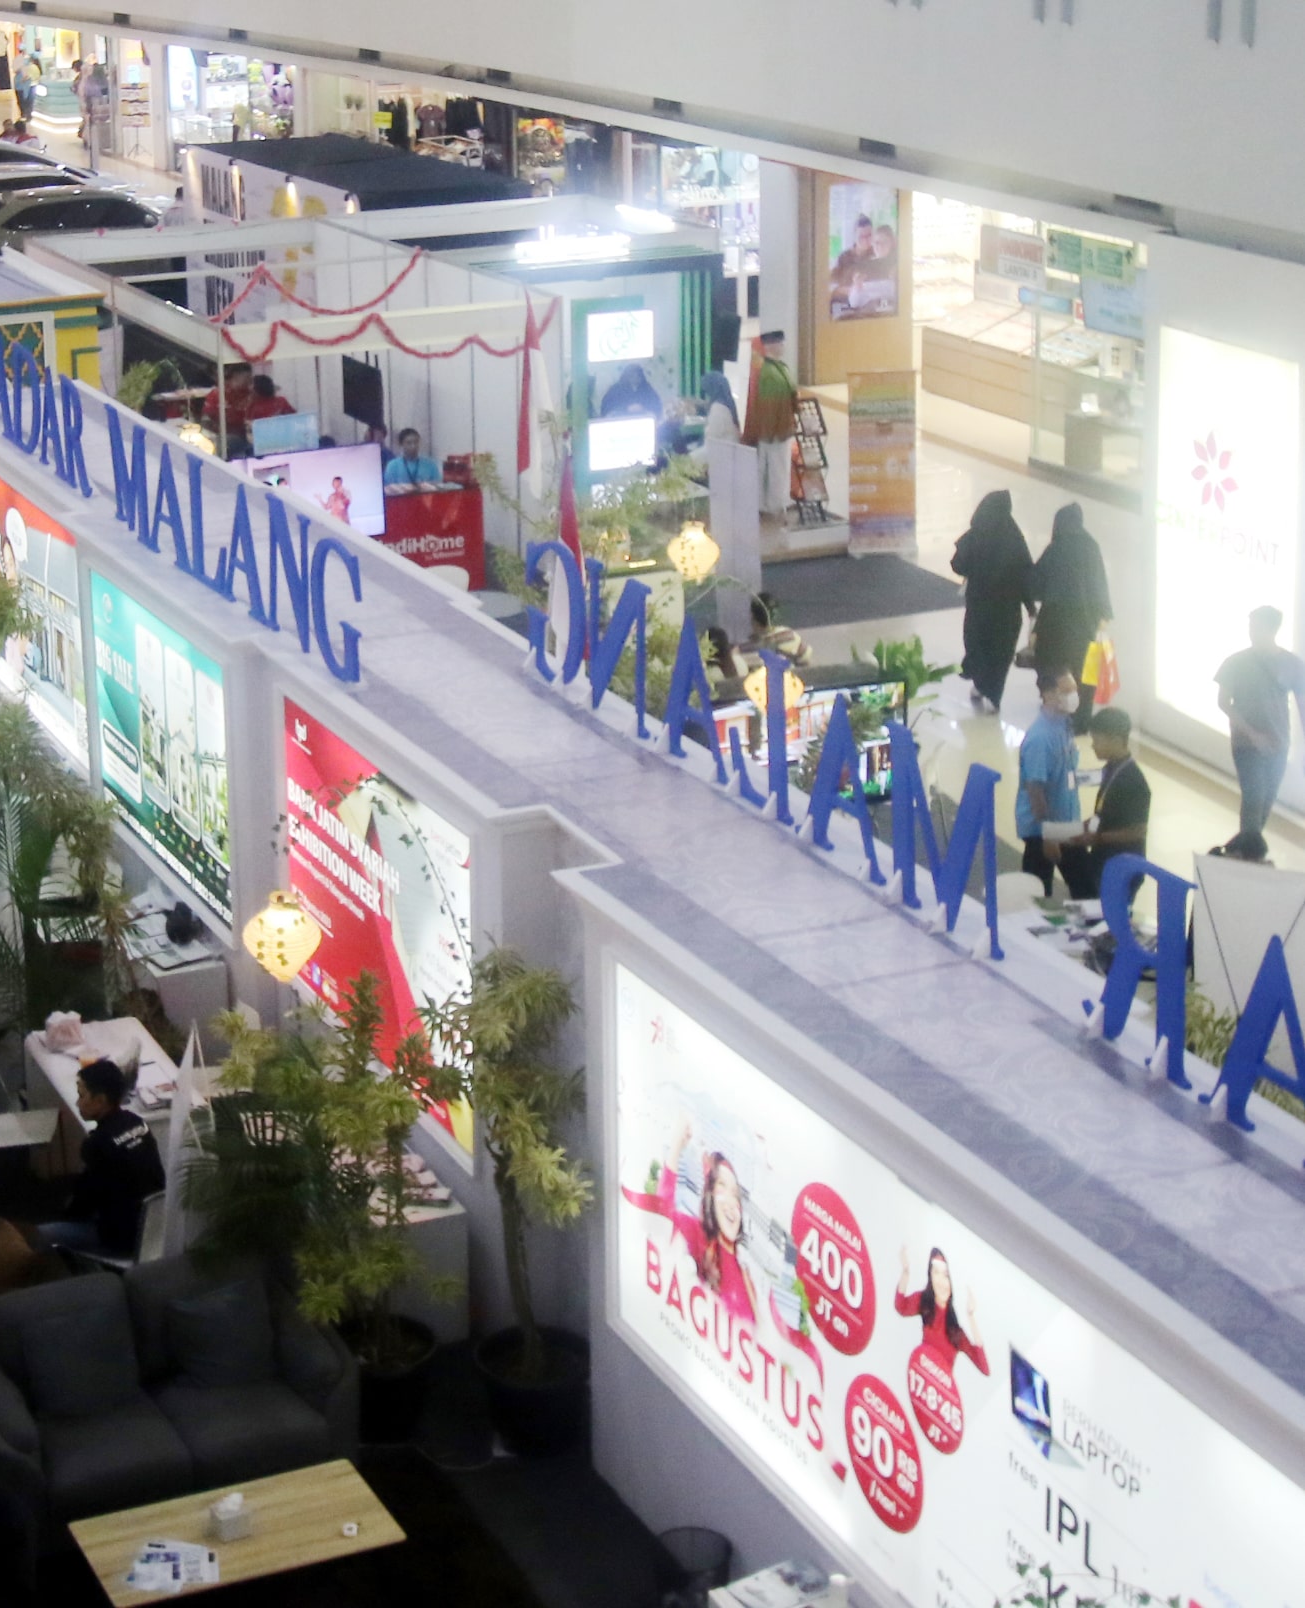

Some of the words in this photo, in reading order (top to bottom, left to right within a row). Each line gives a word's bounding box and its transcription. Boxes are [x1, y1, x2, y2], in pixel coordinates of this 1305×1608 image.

[105, 403, 363, 683] MALANG
[379, 534, 465, 555] ndiHome
[96, 635, 113, 676] BIG
[113, 651, 135, 695] SALE
[287, 777, 318, 823] BANK
[316, 804, 350, 851] JATIM
[348, 832, 400, 894] SYARIAH
[347, 871, 383, 916] WEEK
[803, 1196, 834, 1227] HARGA
[833, 1221, 862, 1253] MULAI
[799, 1227, 864, 1310] 400
[646, 1238, 824, 1452] BAGUSTUS
[815, 1295, 833, 1322] JT
[832, 1315, 849, 1338] an
[862, 1386, 906, 1435] CICILAN
[1062, 1397, 1142, 1475] BERHADIAH
[851, 1405, 895, 1479] 90
[897, 1448, 918, 1483] RB
[1008, 1450, 1039, 1491] free
[1062, 1419, 1141, 1497] LAPTOP
[896, 1472, 916, 1499] an
[1045, 1486, 1100, 1578] IPL
